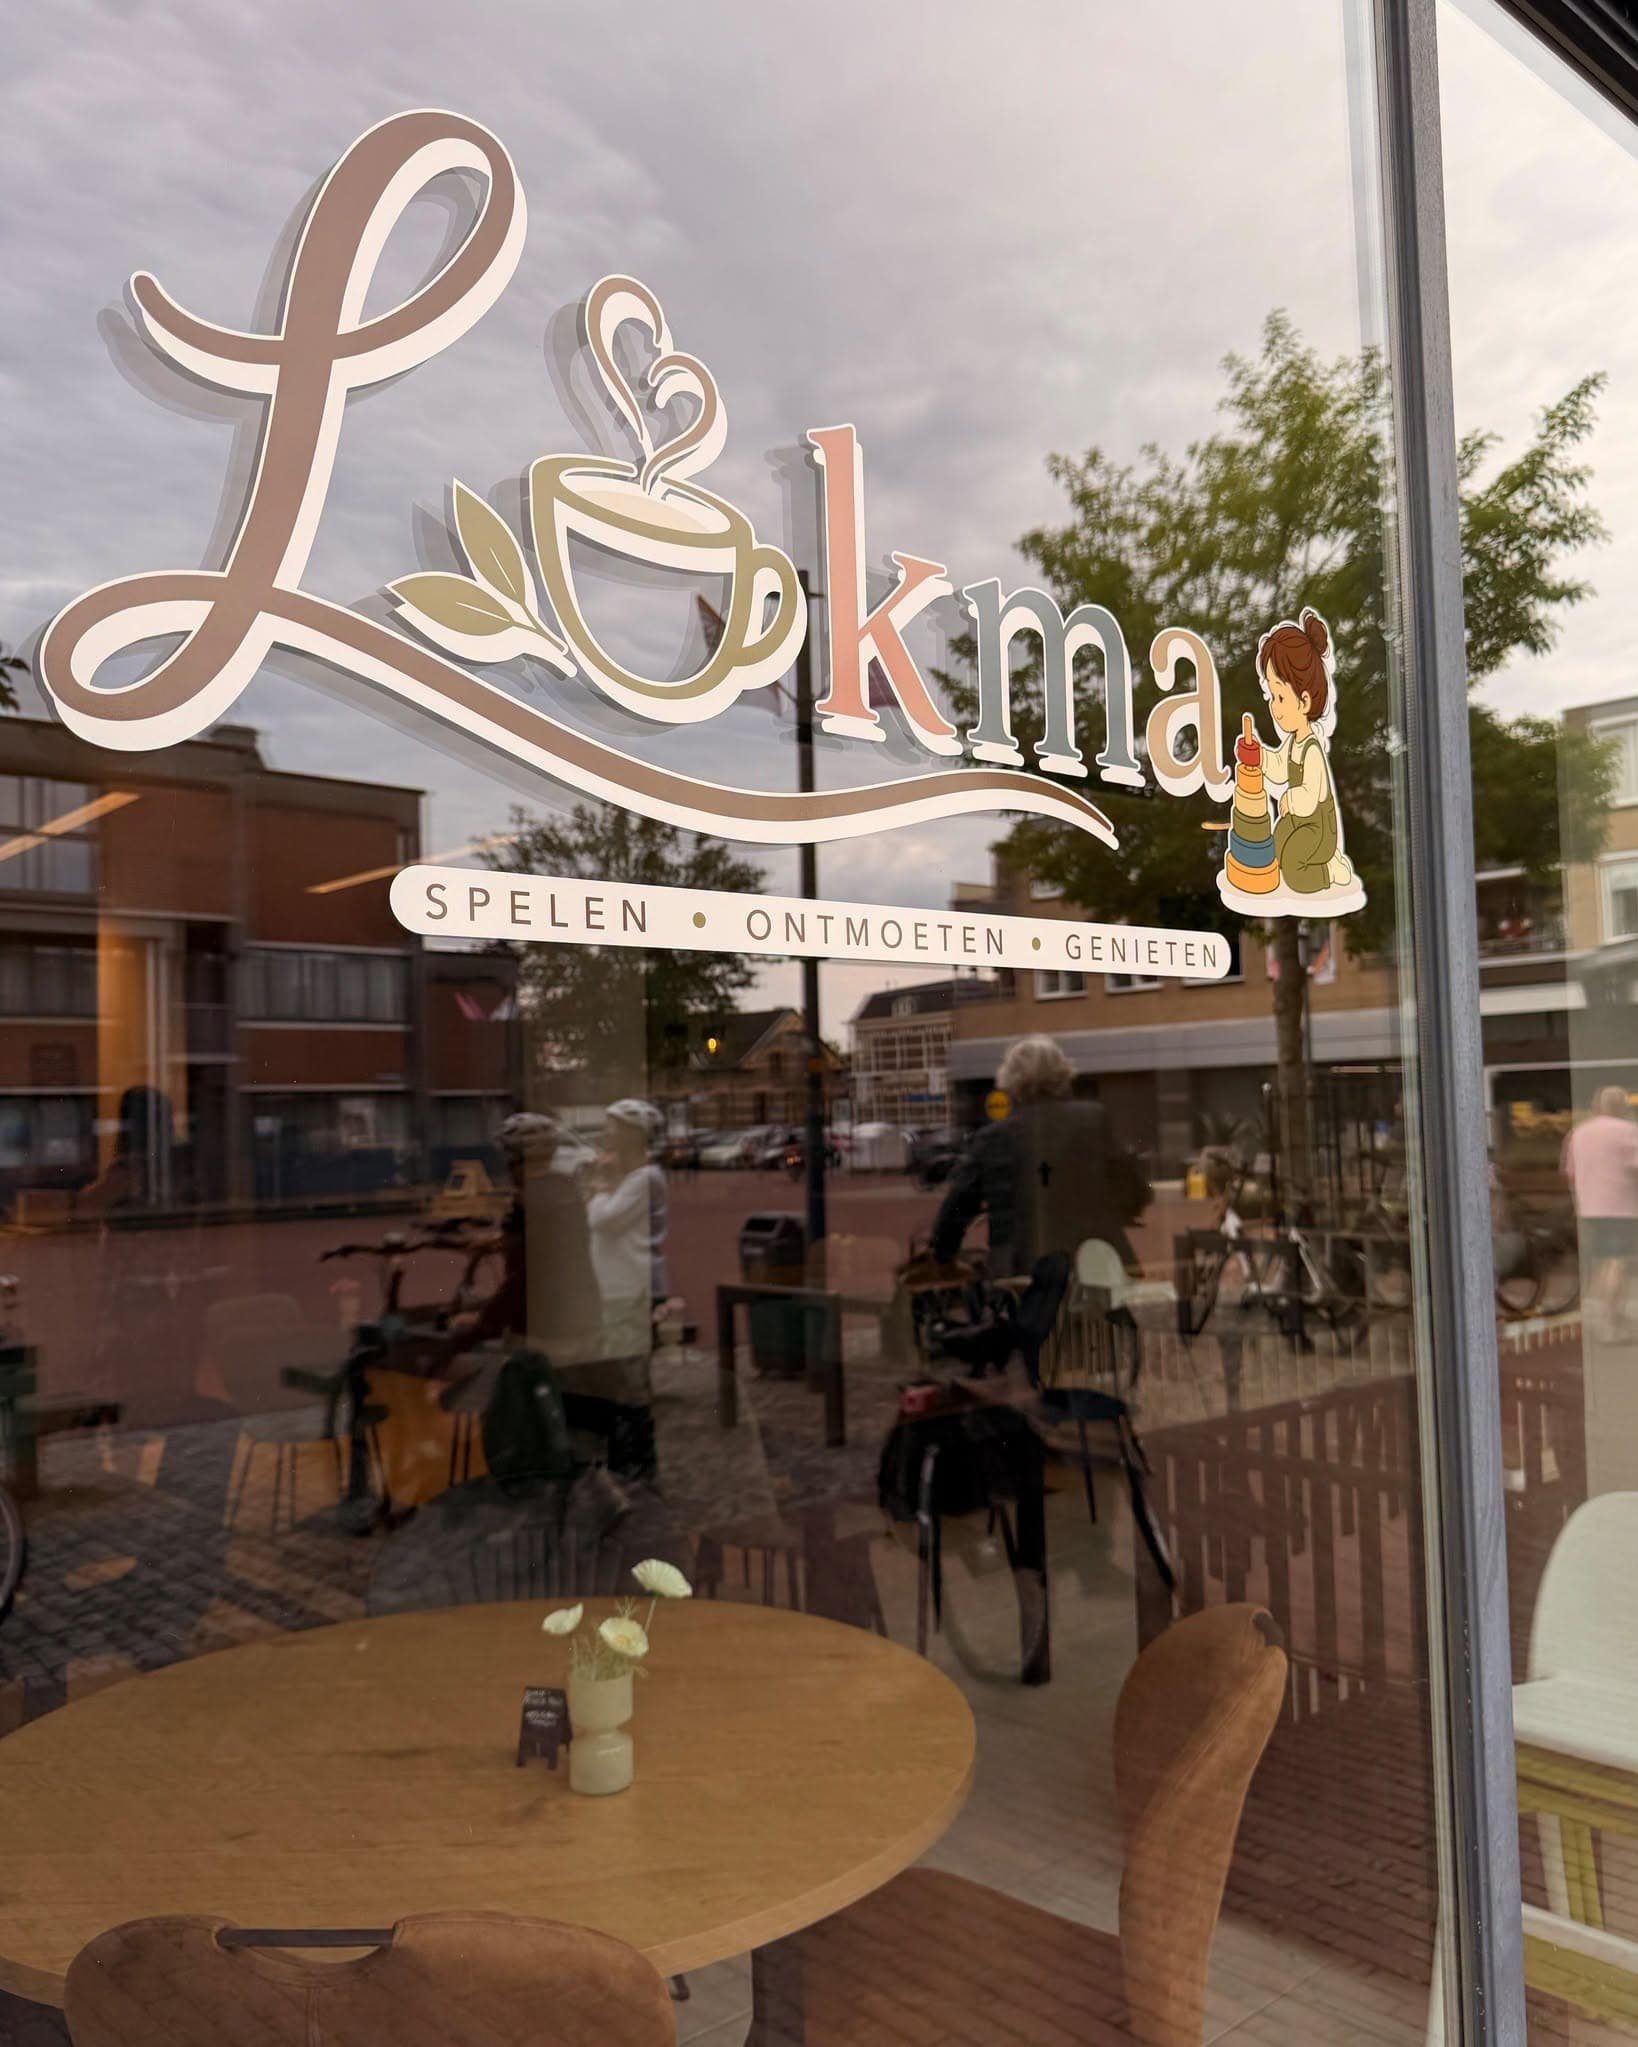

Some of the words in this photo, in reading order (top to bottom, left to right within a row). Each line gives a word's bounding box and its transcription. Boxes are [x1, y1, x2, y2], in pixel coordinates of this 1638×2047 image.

[426, 882, 648, 934] SPELEN
[746, 908, 1005, 956] ONTMOETEN
[1065, 933, 1218, 968] GENIETEN
